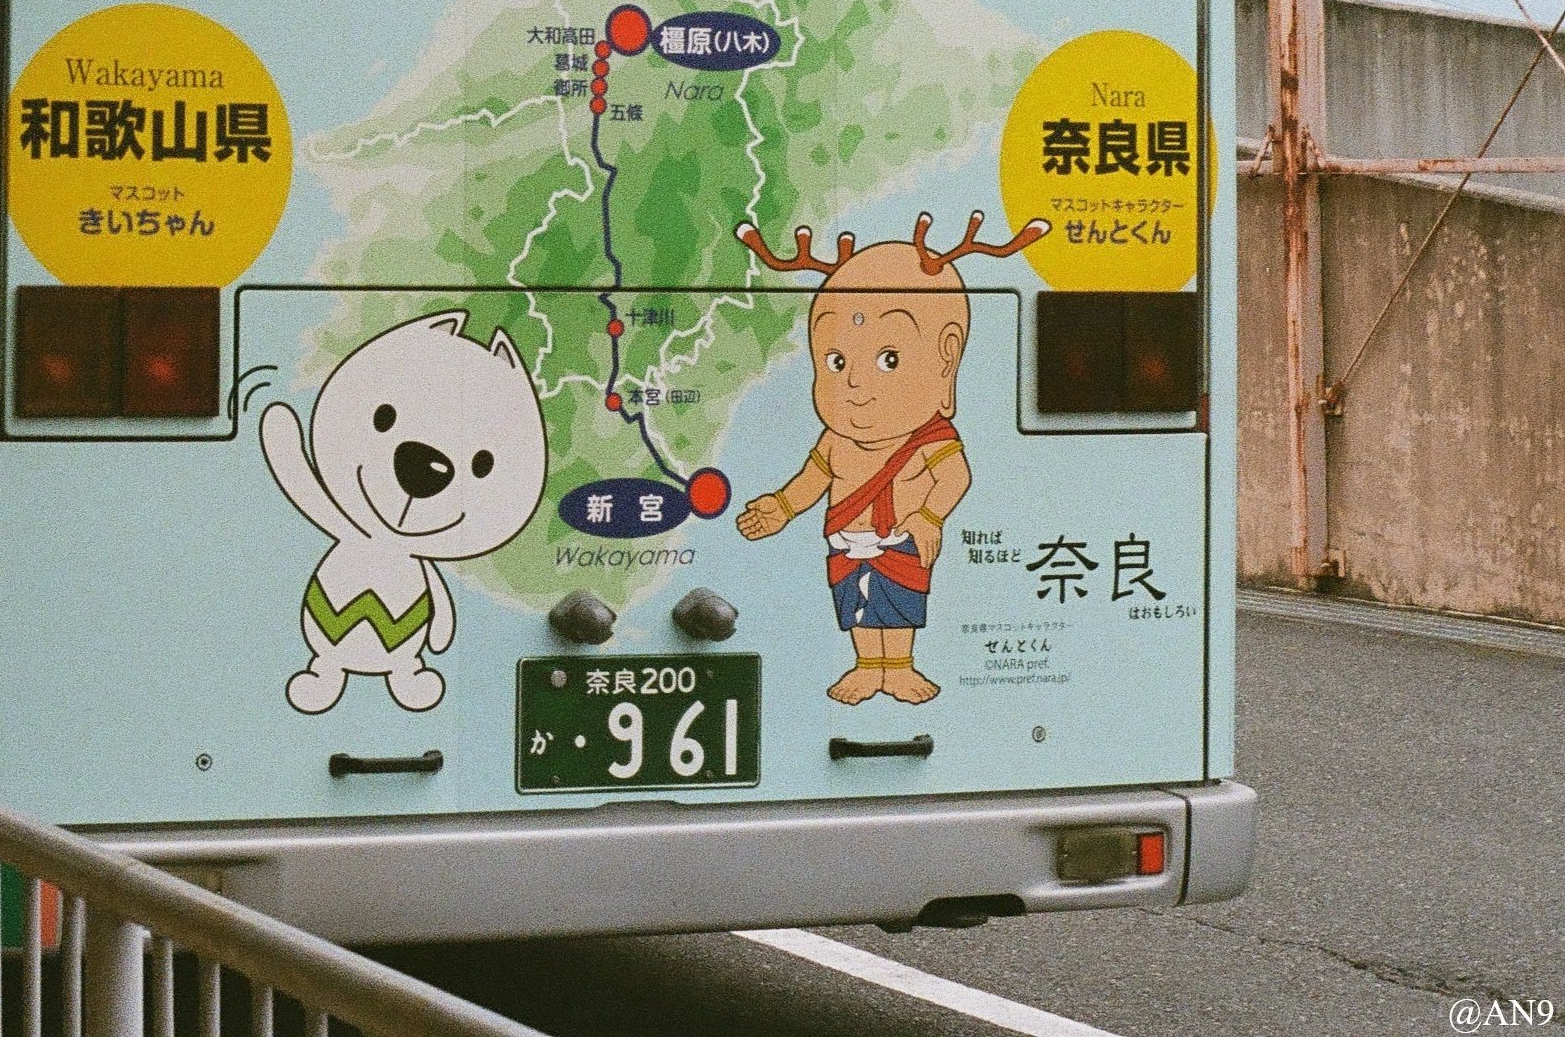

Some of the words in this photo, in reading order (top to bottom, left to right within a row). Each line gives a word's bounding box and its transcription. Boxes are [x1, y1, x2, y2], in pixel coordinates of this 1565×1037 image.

[526, 26, 596, 46] 大和高田
[65, 58, 225, 93] Wakayama
[553, 78, 588, 97] 御所
[664, 80, 725, 102] Nara
[1091, 82, 1146, 108] Nara
[19, 97, 272, 163] 和歌山県
[1041, 117, 1191, 177] 奈良県
[109, 185, 185, 202] マスコット
[1050, 197, 1185, 214] マスコットキャラクター
[77, 208, 216, 237] きいちゃん
[1065, 218, 1172, 246] せんとくん
[625, 307, 676, 327] 十津川
[585, 493, 665, 523] 新宮
[961, 528, 1003, 545] 知れば
[555, 545, 697, 570] Wakayama
[967, 547, 1022, 564] 知るほど
[1026, 532, 1167, 604] 奈良
[1127, 604, 1198, 621] はおもしろい
[984, 638, 1053, 654] せんとくん
[529, 728, 555, 756] か
